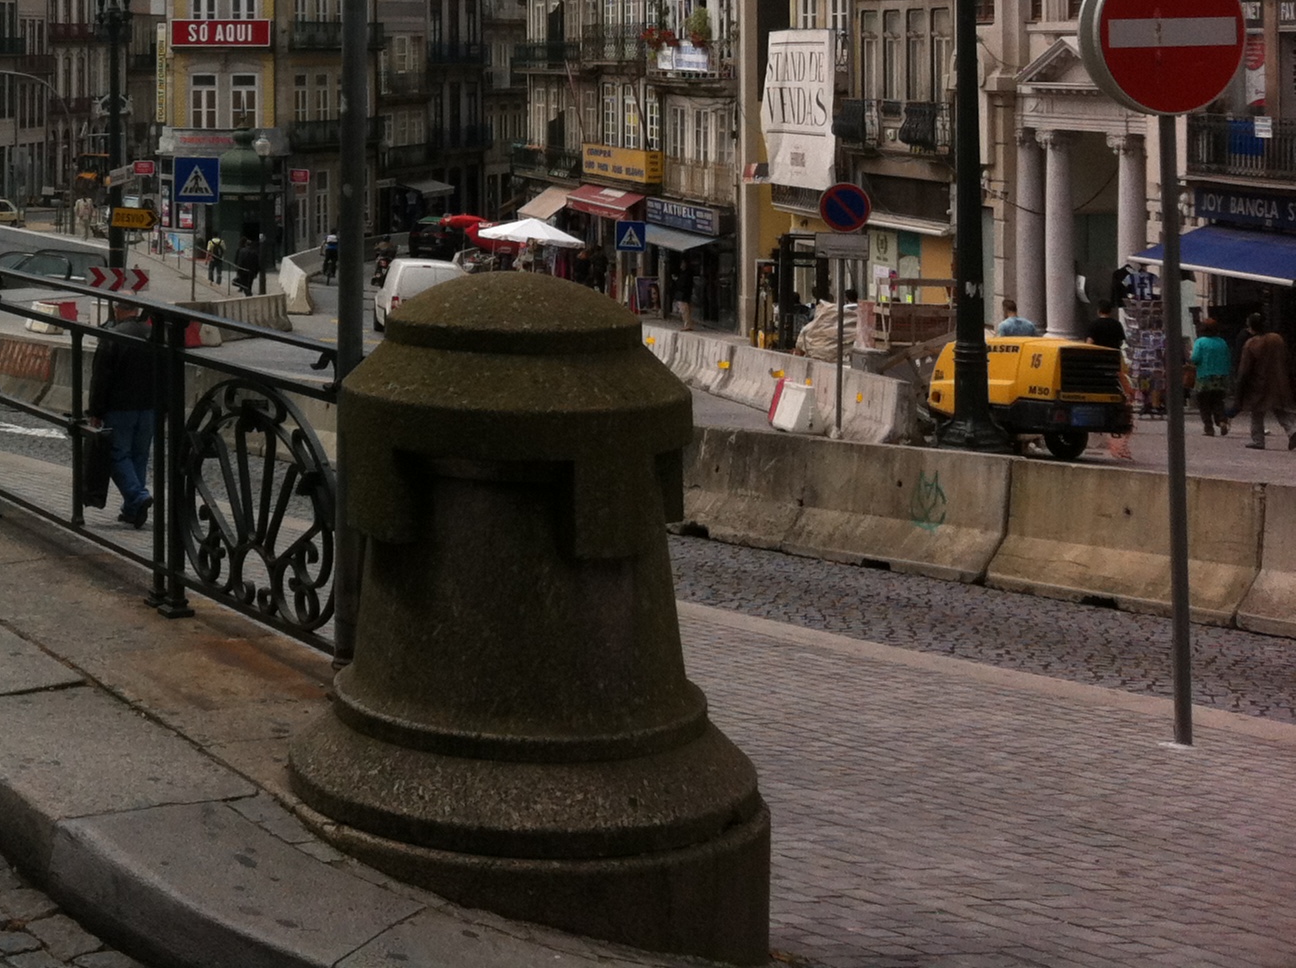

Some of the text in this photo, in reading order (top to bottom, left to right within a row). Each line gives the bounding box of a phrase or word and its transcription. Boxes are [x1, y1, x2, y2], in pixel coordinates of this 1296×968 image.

[1280, 2, 1296, 20] FAX
[188, 21, 253, 42] SÓ AQUI
[767, 51, 825, 83] STAND DE
[766, 87, 828, 127] VENDAS
[663, 202, 696, 220] AKTUELL
[1202, 194, 1224, 213] JOY
[1230, 196, 1280, 220] BANGLA
[115, 213, 144, 224] DESVIO
[1030, 353, 1043, 369] 15
